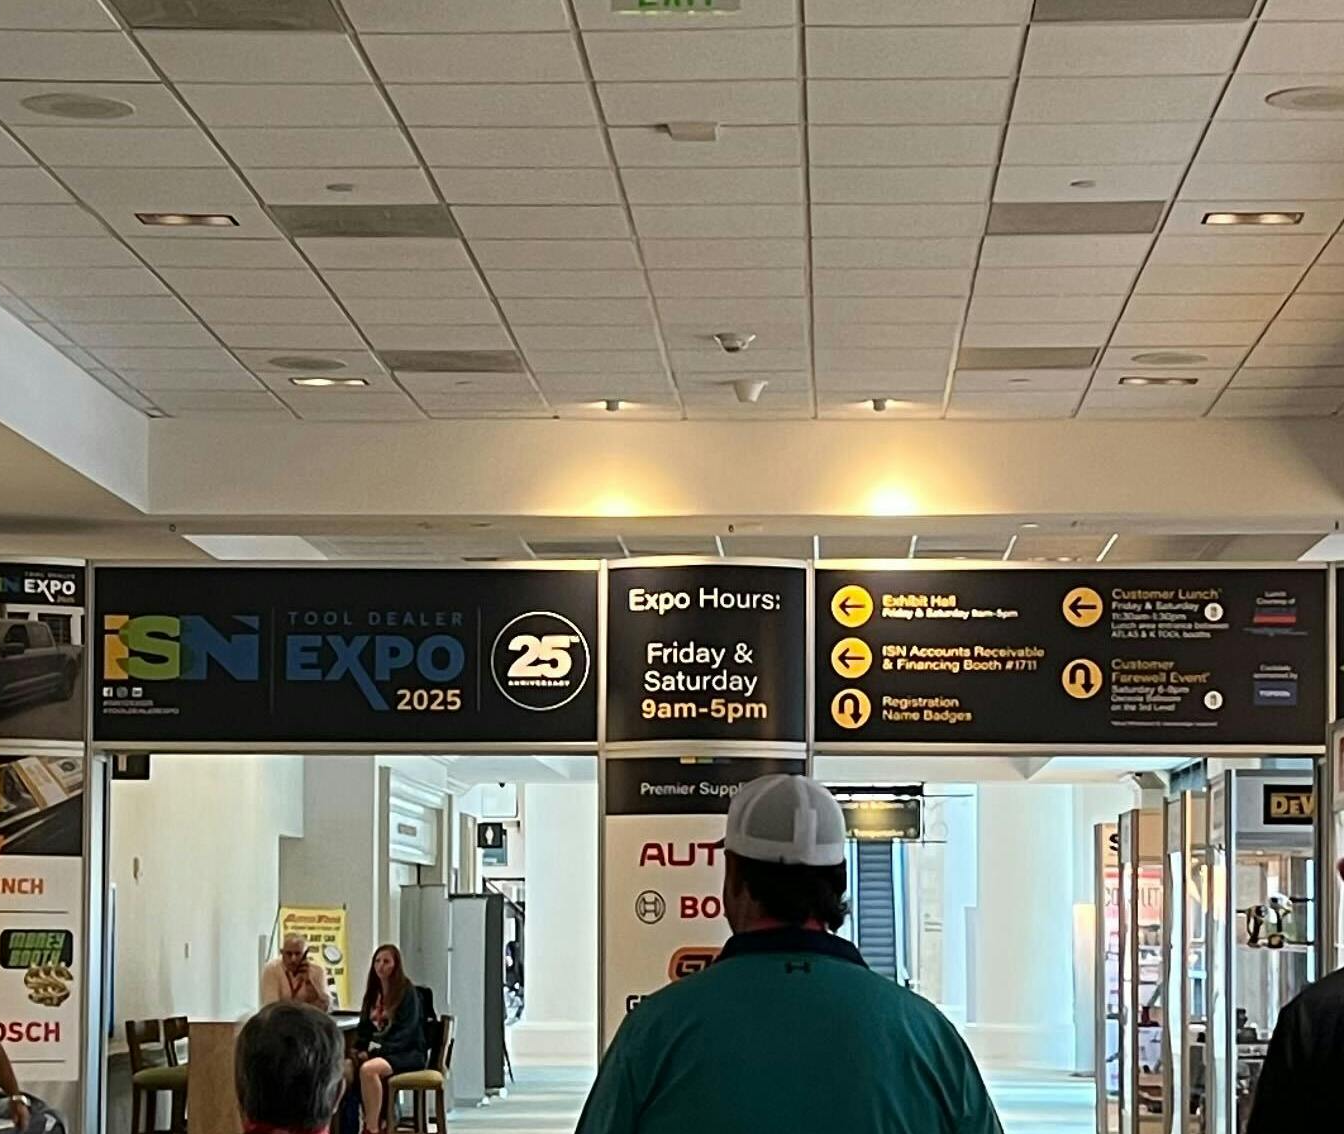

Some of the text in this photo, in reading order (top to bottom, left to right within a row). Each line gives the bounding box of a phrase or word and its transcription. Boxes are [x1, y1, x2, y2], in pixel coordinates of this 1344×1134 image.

[24, 579, 76, 602] EXPO
[1112, 588, 1175, 600] Customer
[629, 588, 781, 615] Expo Hours:
[882, 595, 956, 607] Exhibit Hall
[287, 611, 464, 626] TOOL DEALER
[647, 641, 753, 669] Friday &
[882, 645, 1045, 657] ISN Accounts Receivable
[882, 659, 1038, 673] & Financing Booth #1711
[1111, 659, 1175, 670] Customer
[286, 634, 465, 711] EXPO
[1111, 672, 1167, 683] Farewell
[644, 669, 757, 697] Saturday
[396, 689, 462, 710] 2025
[882, 696, 960, 710] Registration
[641, 698, 768, 724] 9am-5pm
[882, 709, 973, 723] Name Badges
[640, 781, 695, 796] Premier
[9, 932, 65, 949] MONEY
